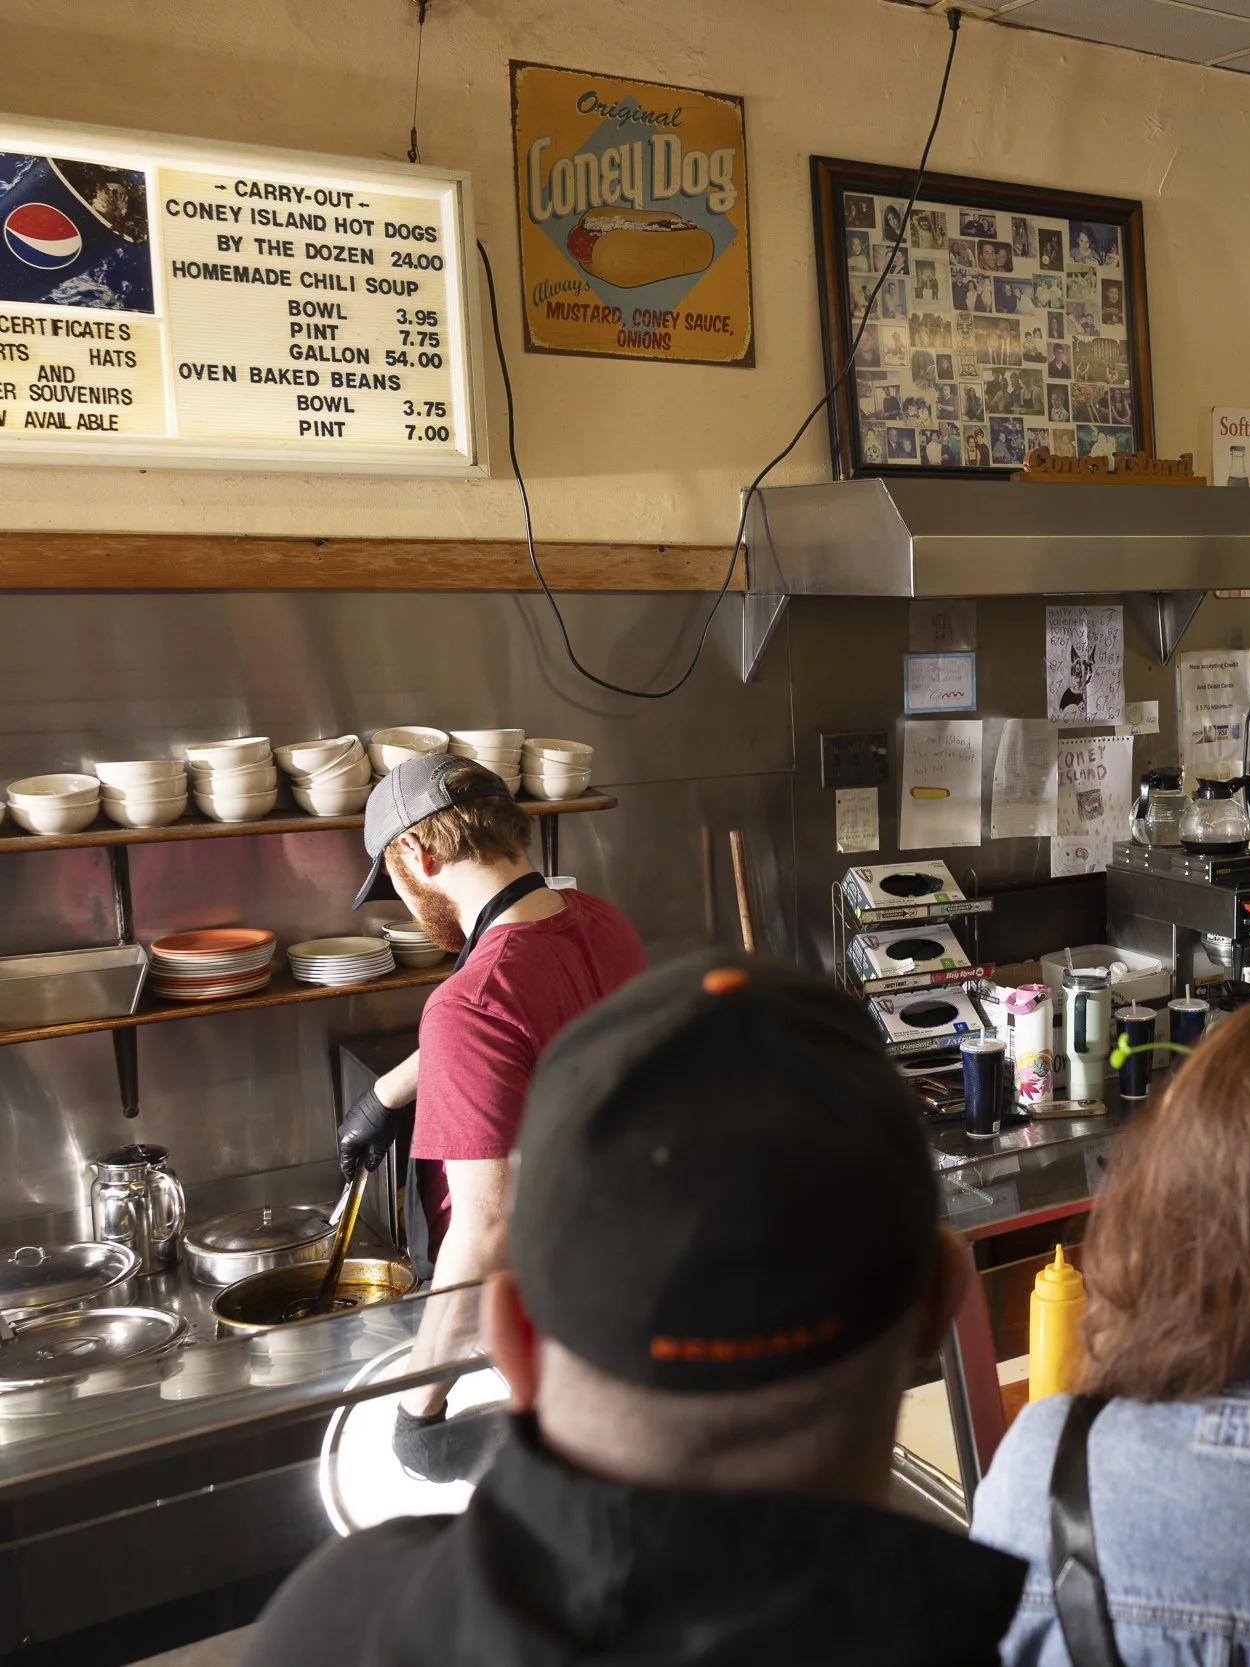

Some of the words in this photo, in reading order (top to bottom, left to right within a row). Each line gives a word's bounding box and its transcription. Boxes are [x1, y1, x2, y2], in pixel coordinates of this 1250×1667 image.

[576, 90, 684, 128] Original
[528, 136, 644, 223] Coney
[650, 132, 738, 214] Dog
[234, 180, 354, 209] CARRY-OUT
[166, 199, 241, 225] CONEY
[251, 208, 327, 232] ISLAND
[335, 214, 375, 237] HOT
[385, 222, 437, 243] DOGS
[217, 235, 243, 253] BY
[254, 238, 294, 259] THE
[305, 243, 375, 265] DOZEN
[391, 251, 444, 272] 24.00
[173, 261, 292, 288] HOMEMADE
[300, 272, 355, 292] CHILI
[366, 278, 419, 298] SOUP
[533, 278, 593, 308] Always
[0, 314, 131, 341] CERTIFICATES
[288, 300, 348, 321] BOWL
[396, 309, 438, 328] 3.95
[546, 301, 626, 328] MUSTARD,
[632, 308, 681, 330] CONEY
[685, 313, 735, 337] SAUCE,
[290, 322, 338, 341] PINT
[399, 330, 440, 349] 7.75
[617, 329, 672, 351] ONIONS
[89, 348, 137, 368] HATS
[289, 344, 370, 365] GALLON
[385, 350, 442, 369] 54.00
[37, 364, 76, 383] AND
[178, 363, 237, 383] OVEN
[250, 365, 320, 388] BAKED
[331, 370, 401, 391] BEANS
[29, 384, 133, 406] SOUVENIRS
[297, 395, 355, 414] BOWL
[403, 400, 446, 418] 3.75
[299, 420, 346, 438] PINT
[404, 425, 449, 443] 7.00
[1220, 416, 1250, 437] Soft
[1112, 451, 1194, 476] Island
[946, 971, 959, 980] Big
[960, 969, 976, 978] Red
